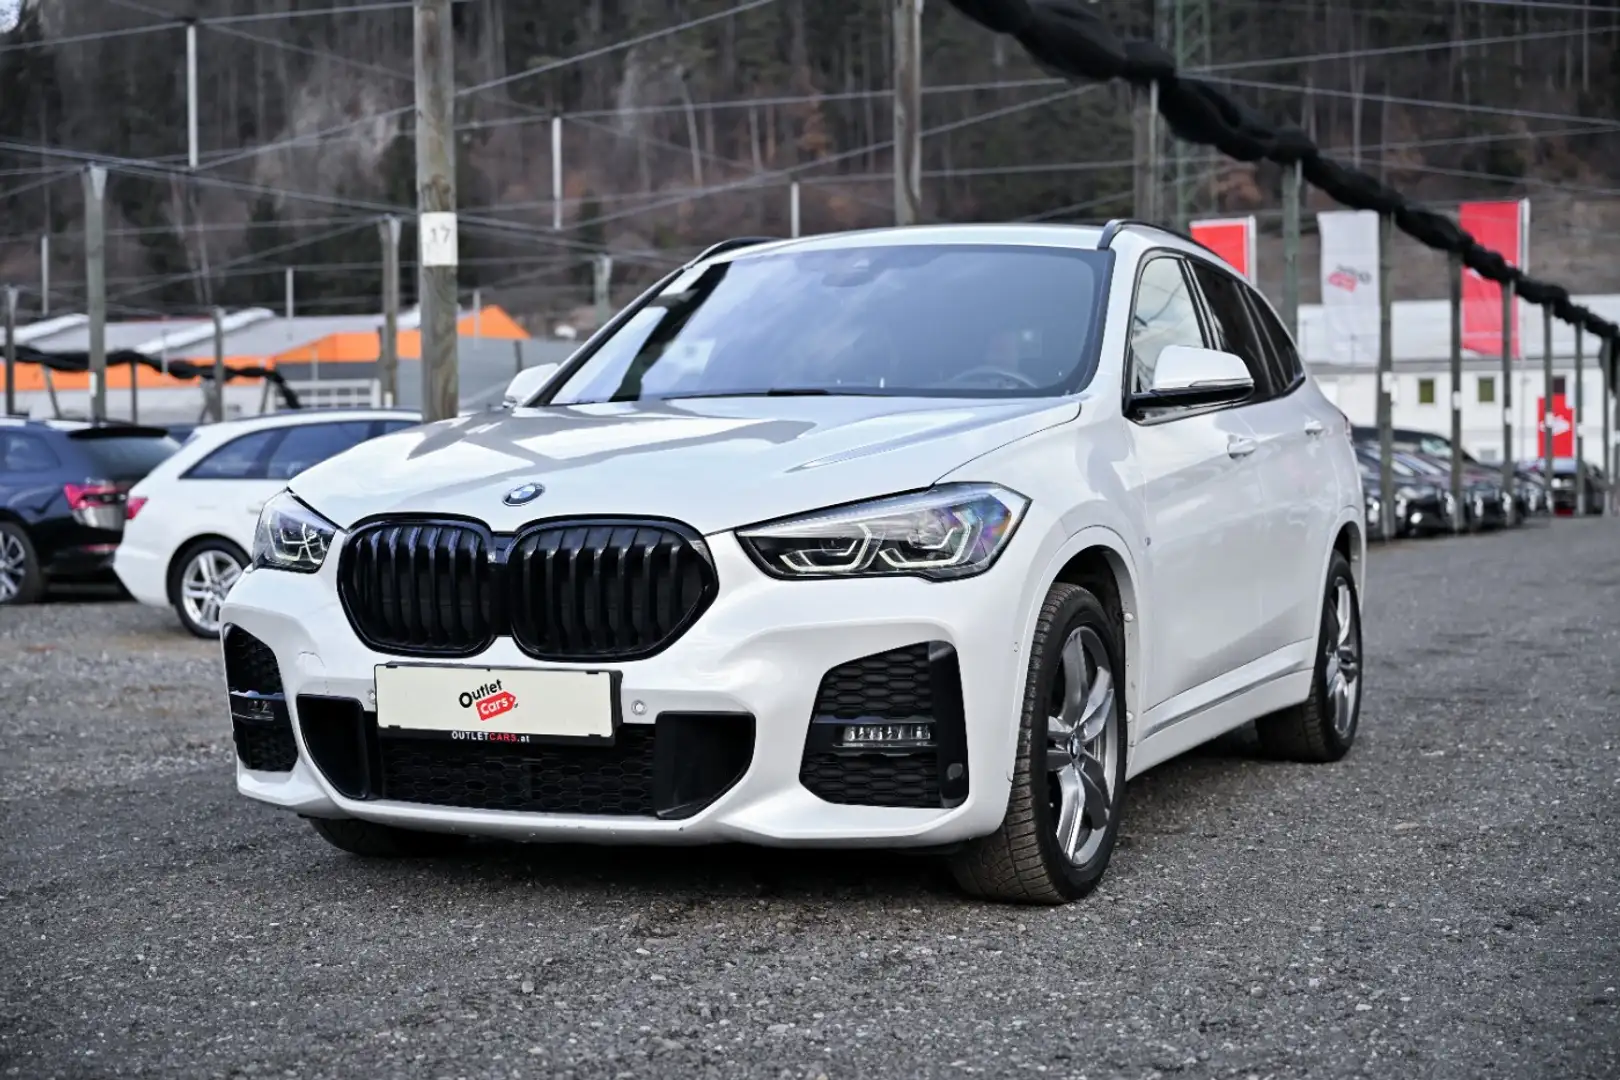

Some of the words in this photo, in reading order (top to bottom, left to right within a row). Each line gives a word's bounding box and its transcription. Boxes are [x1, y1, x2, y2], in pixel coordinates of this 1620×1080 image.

[430, 224, 451, 244] 17
[458, 679, 503, 708] Outlet
[480, 697, 509, 715] Cars
[451, 730, 530, 743] OUTLETCARS.at
